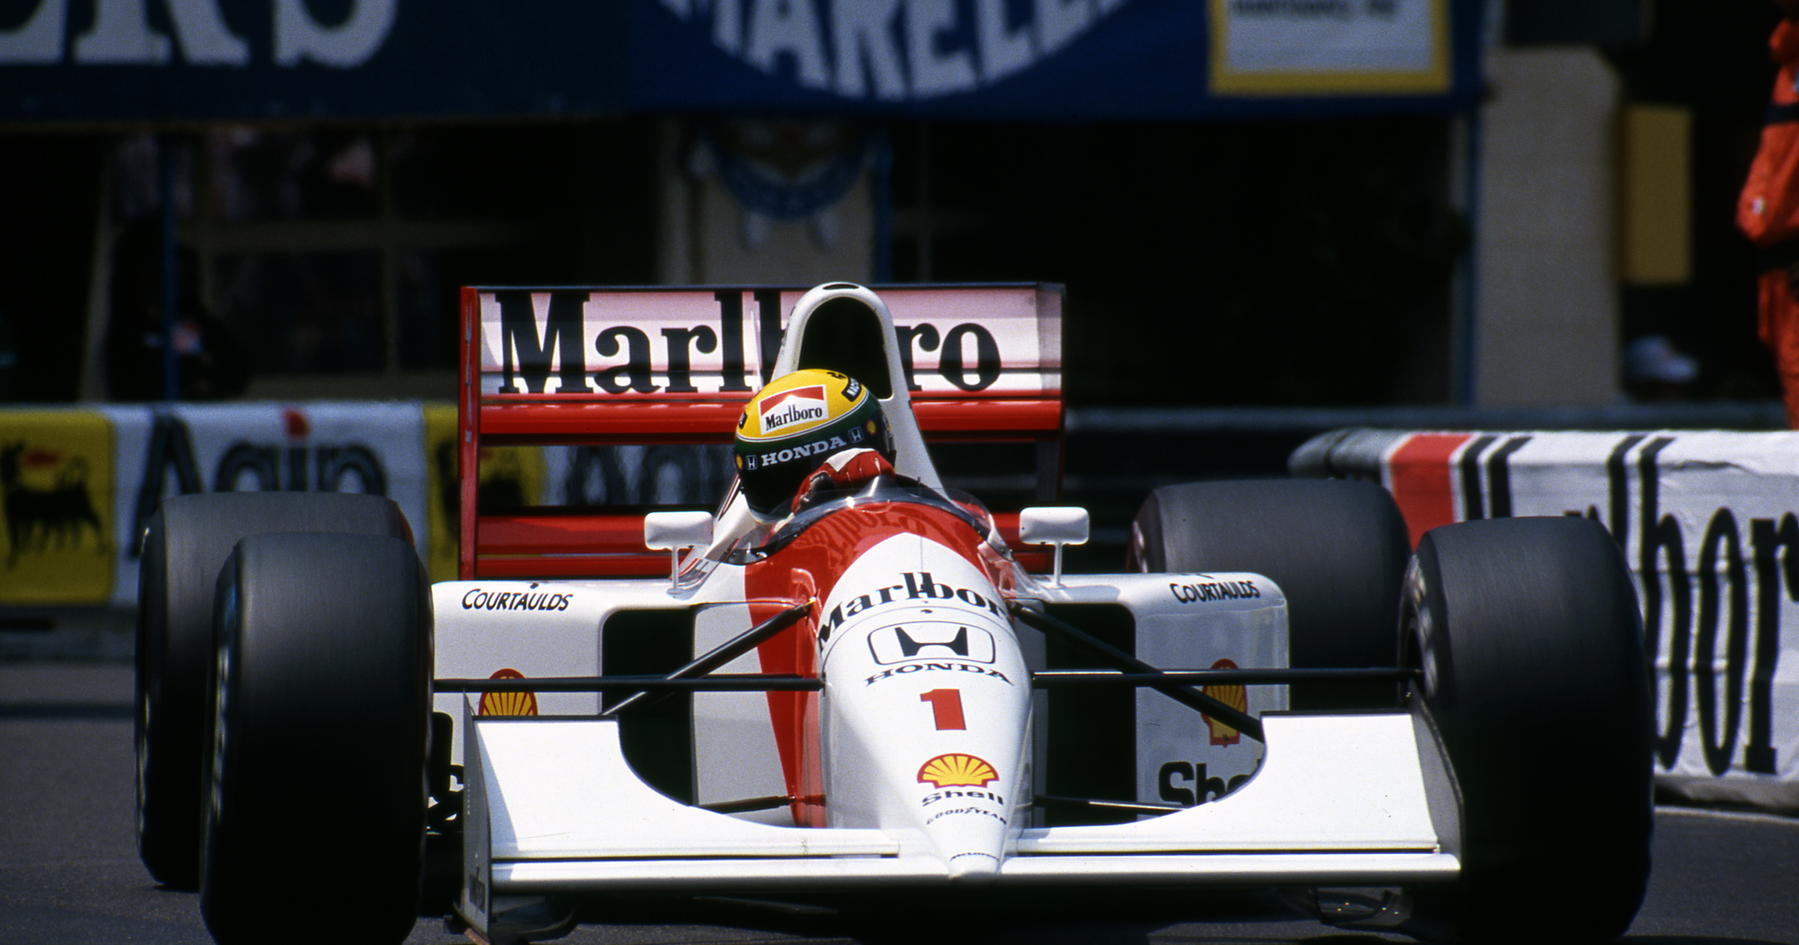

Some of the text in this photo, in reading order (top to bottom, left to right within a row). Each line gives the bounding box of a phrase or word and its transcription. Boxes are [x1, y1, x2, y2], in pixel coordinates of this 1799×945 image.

[657, 0, 1122, 99] AREL
[496, 291, 1001, 393] Marlro
[765, 405, 823, 431] Marlboro
[761, 436, 846, 467] HONDA
[461, 588, 574, 611] COURTAULDS
[1169, 581, 1262, 604] COURTAULDS
[817, 571, 1010, 651] Marlbor
[864, 663, 1015, 687] HONDA
[919, 688, 968, 731] 1
[922, 790, 1004, 808] Shell
